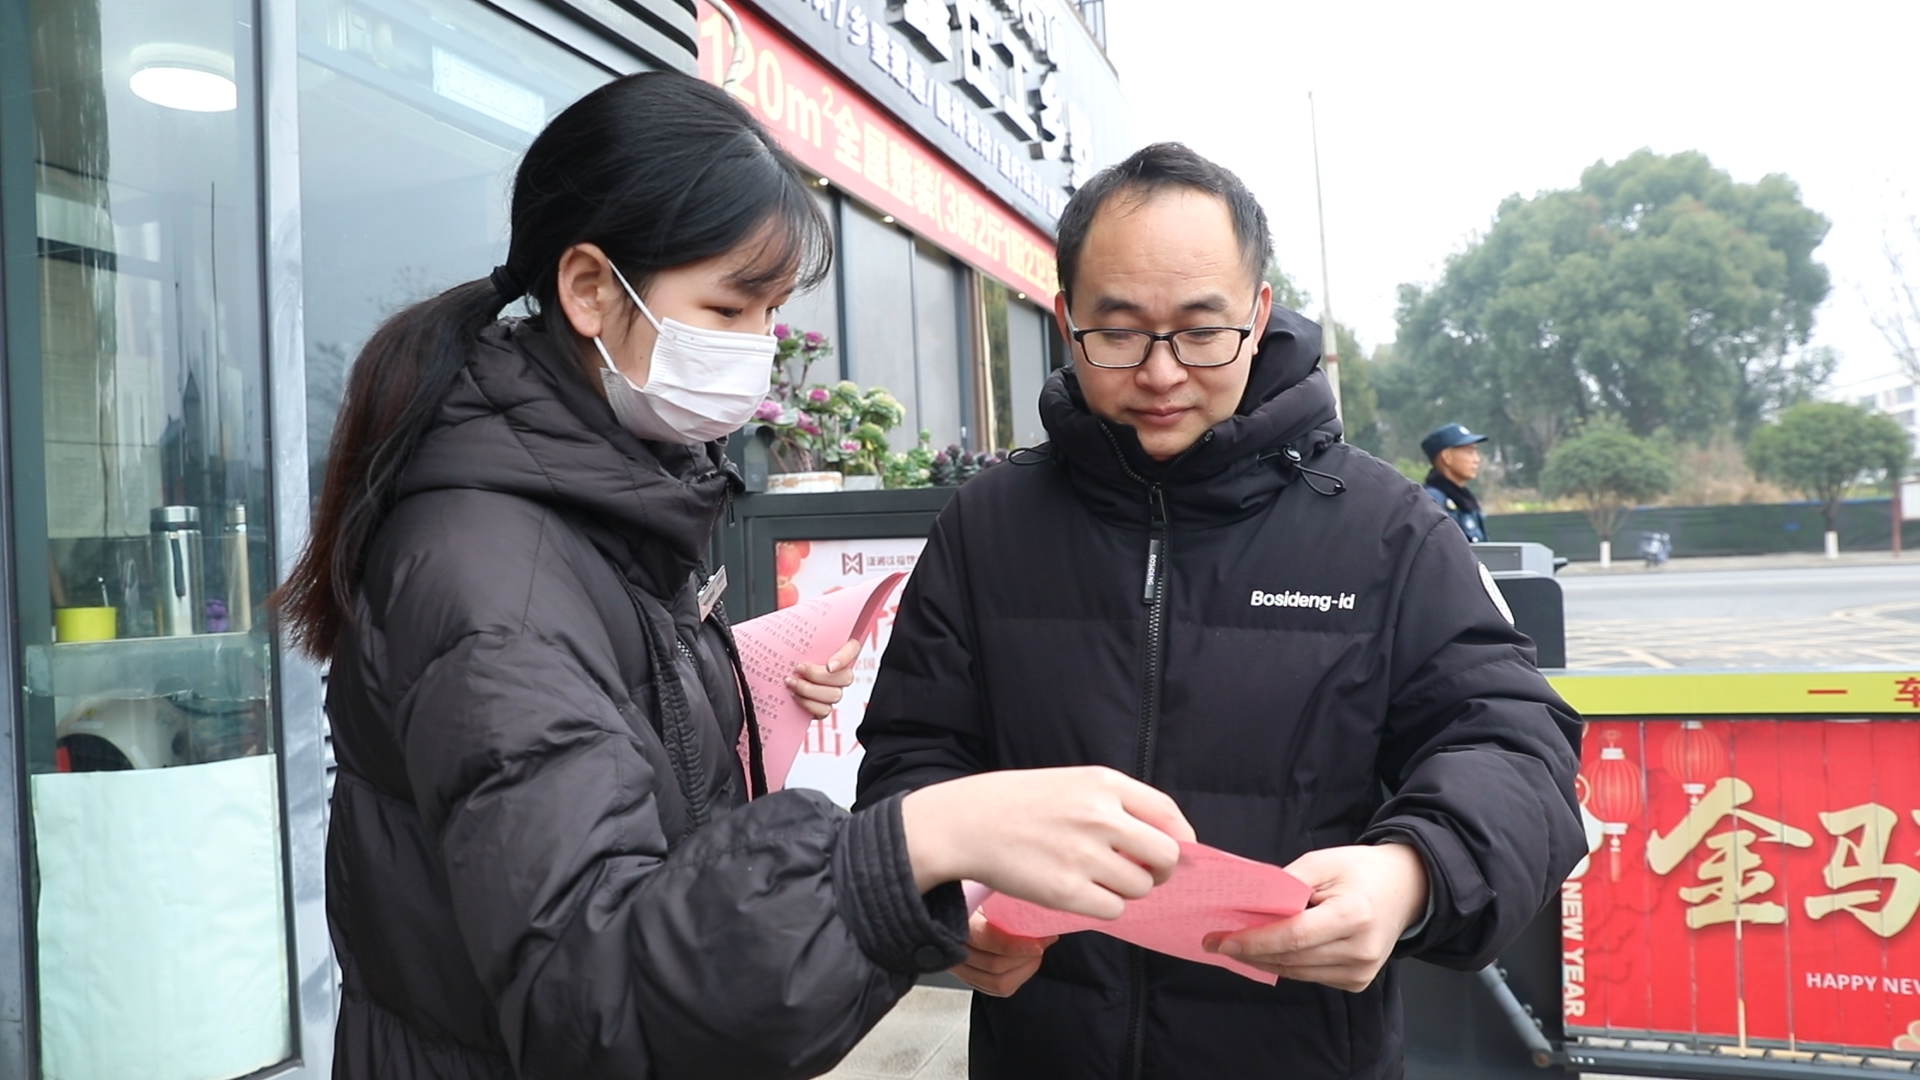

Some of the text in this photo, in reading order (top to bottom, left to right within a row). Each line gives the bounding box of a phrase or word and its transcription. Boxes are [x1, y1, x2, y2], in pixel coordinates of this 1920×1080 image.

[1250, 590, 1355, 612] Bosideng-id
[1646, 777, 1920, 938] 金马
[1561, 881, 1586, 1018] NEW YEAR
[1806, 972, 1877, 992] HAPPY
